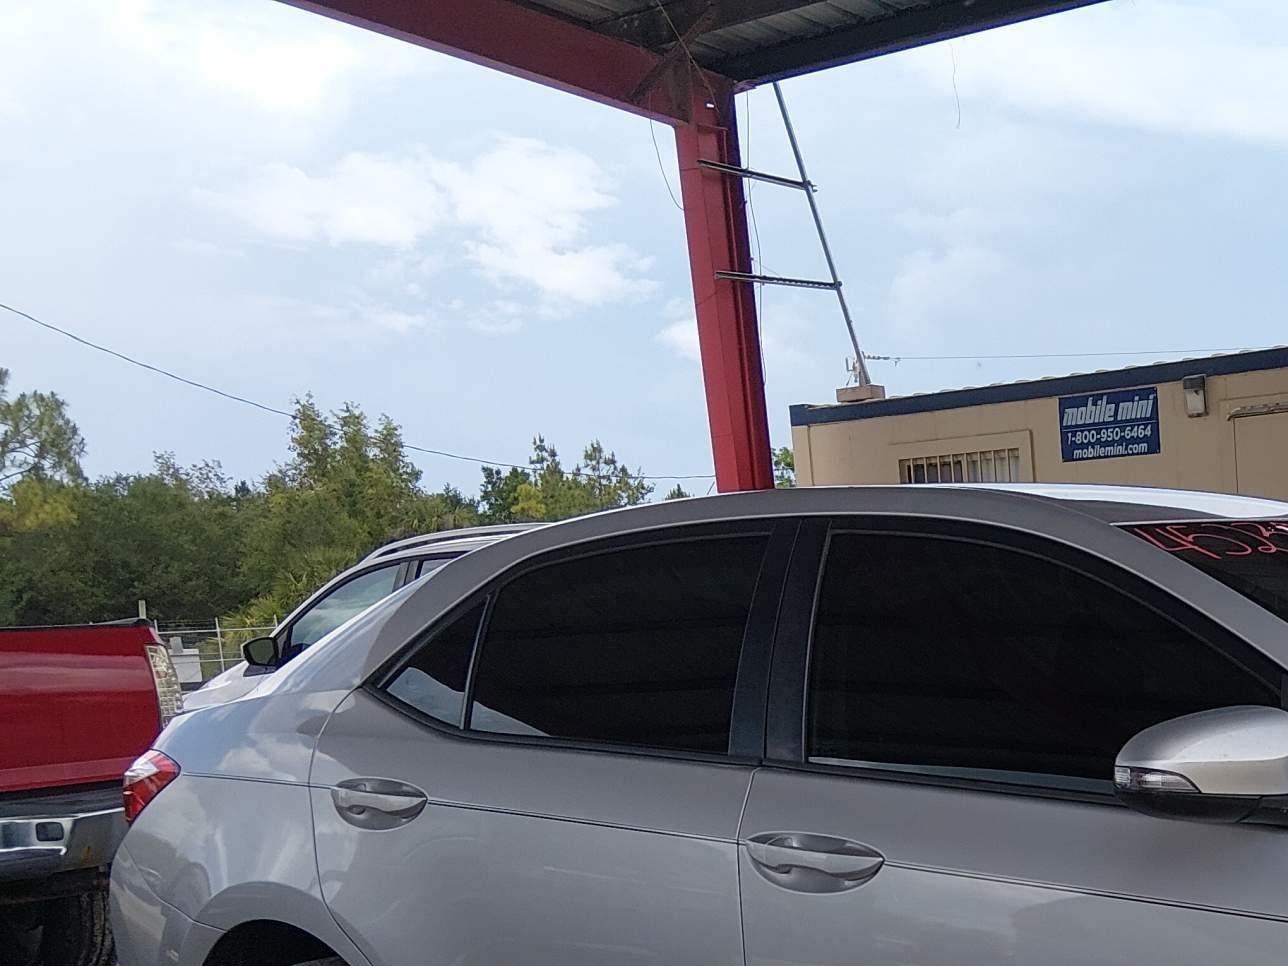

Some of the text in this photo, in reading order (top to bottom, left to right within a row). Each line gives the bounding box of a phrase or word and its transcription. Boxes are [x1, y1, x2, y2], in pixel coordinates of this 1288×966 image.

[1062, 393, 1154, 427] mobile mini
[1067, 424, 1152, 446] 1-800-950-6464
[1073, 442, 1148, 459] mobilemini.com
